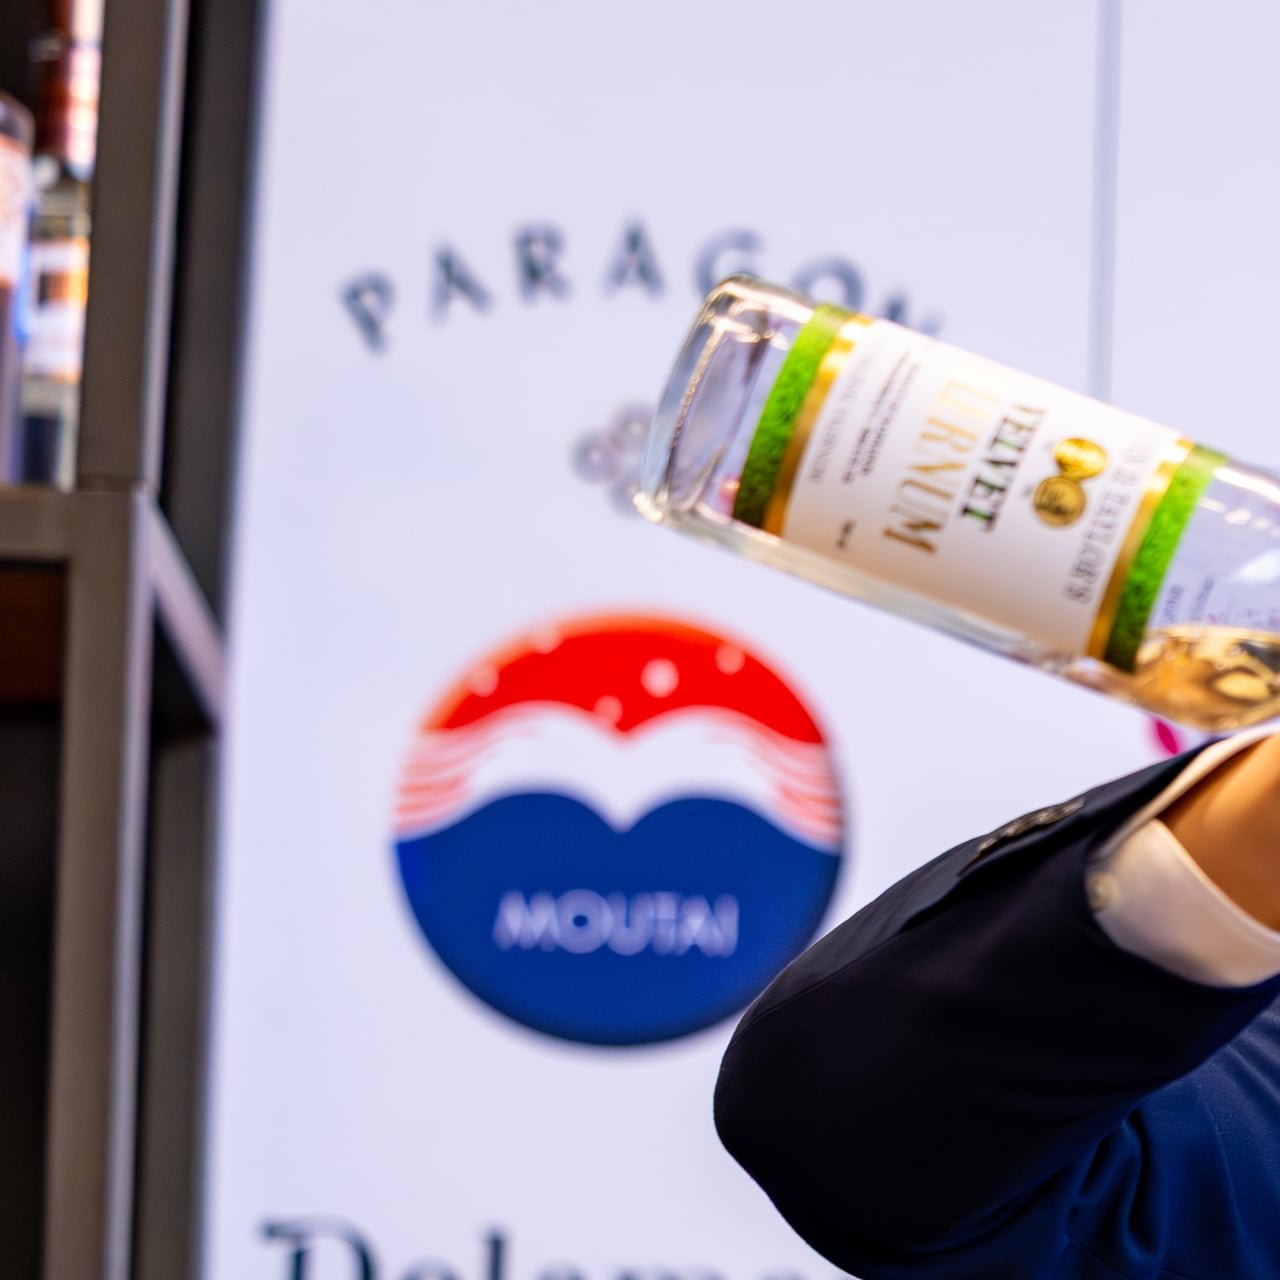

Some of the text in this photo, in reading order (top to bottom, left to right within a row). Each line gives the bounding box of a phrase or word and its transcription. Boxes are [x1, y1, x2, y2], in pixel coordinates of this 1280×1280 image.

[338, 215, 945, 356] PARAGO
[955, 405, 1046, 536] VELVET
[492, 888, 742, 958] MOUTAI
